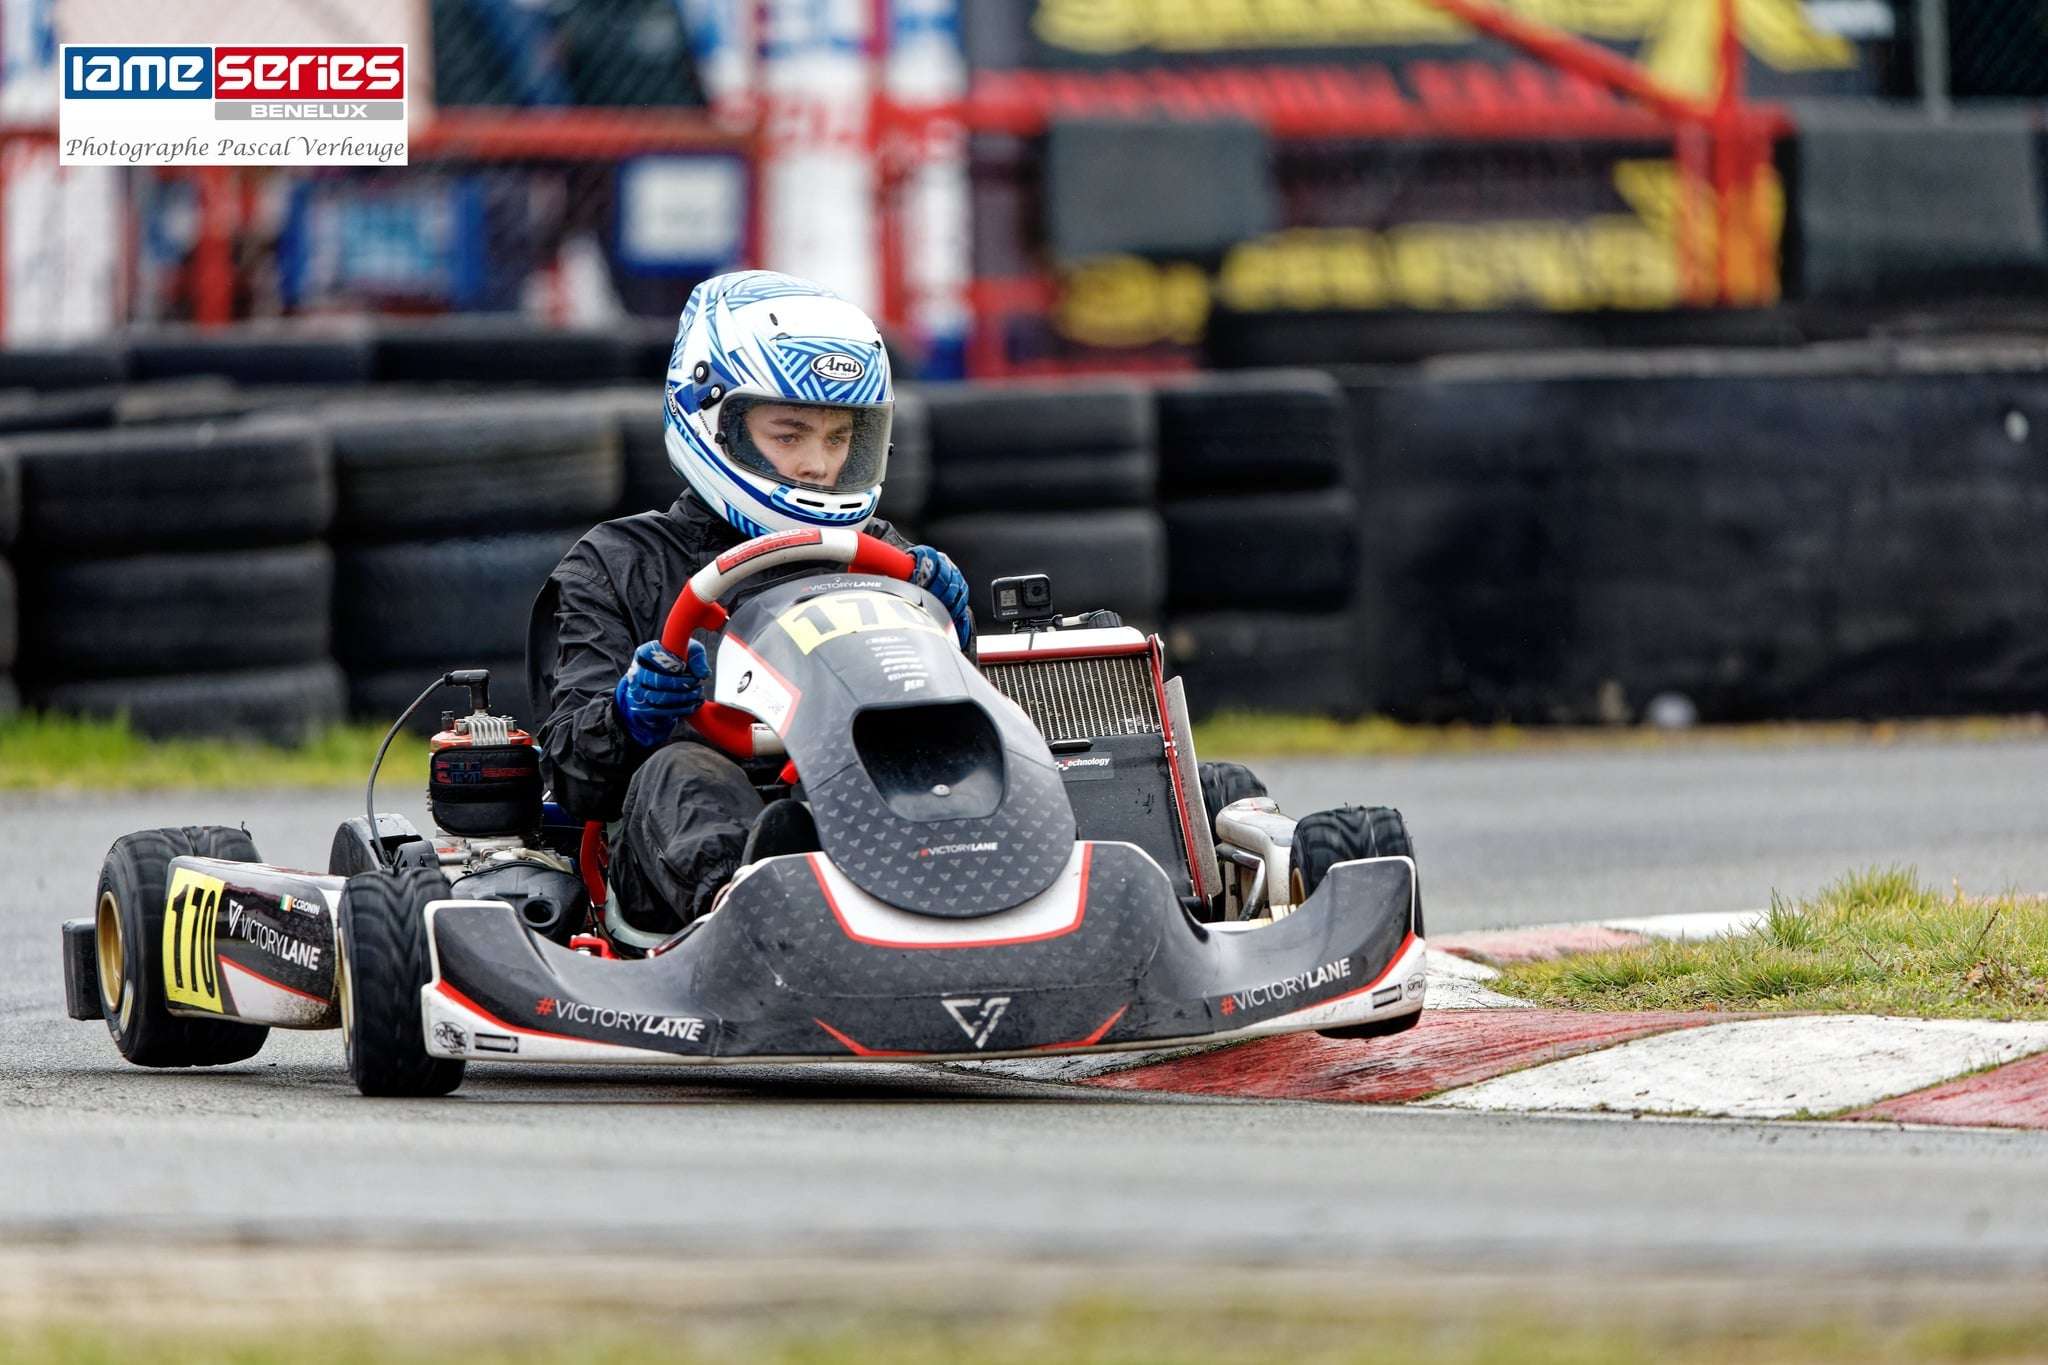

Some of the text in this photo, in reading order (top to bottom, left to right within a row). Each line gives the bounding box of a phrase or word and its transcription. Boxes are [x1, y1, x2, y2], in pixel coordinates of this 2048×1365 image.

[818, 357, 857, 373] Arai
[172, 884, 216, 998] 170
[241, 913, 321, 971] VICTORYLANE
[1221, 958, 1352, 1015] #VICTORYLANE
[535, 997, 706, 1041] #VICTORYLANE
